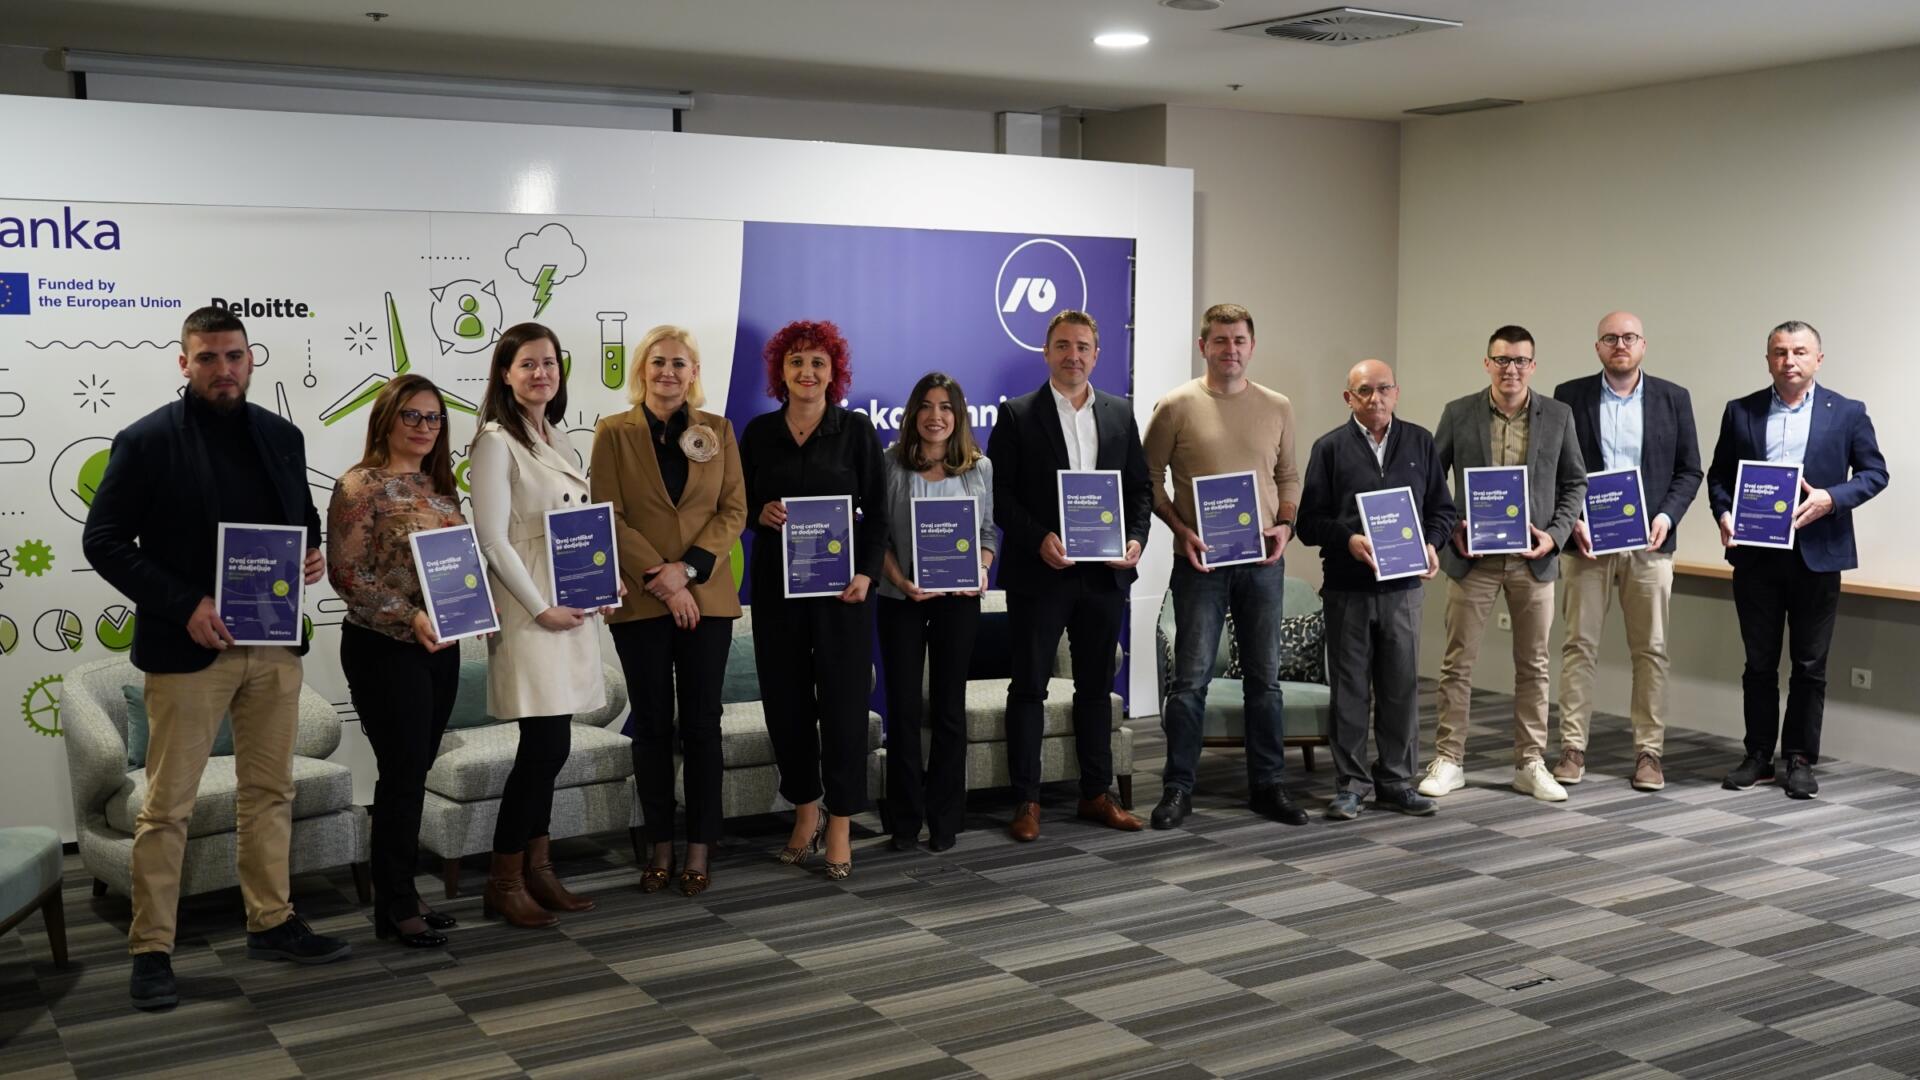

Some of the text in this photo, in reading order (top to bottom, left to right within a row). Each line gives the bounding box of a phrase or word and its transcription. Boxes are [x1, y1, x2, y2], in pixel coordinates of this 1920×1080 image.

[38, 278, 116, 293] Funded by
[38, 296, 182, 310] the European Union
[229, 557, 246, 565] Ovaj
